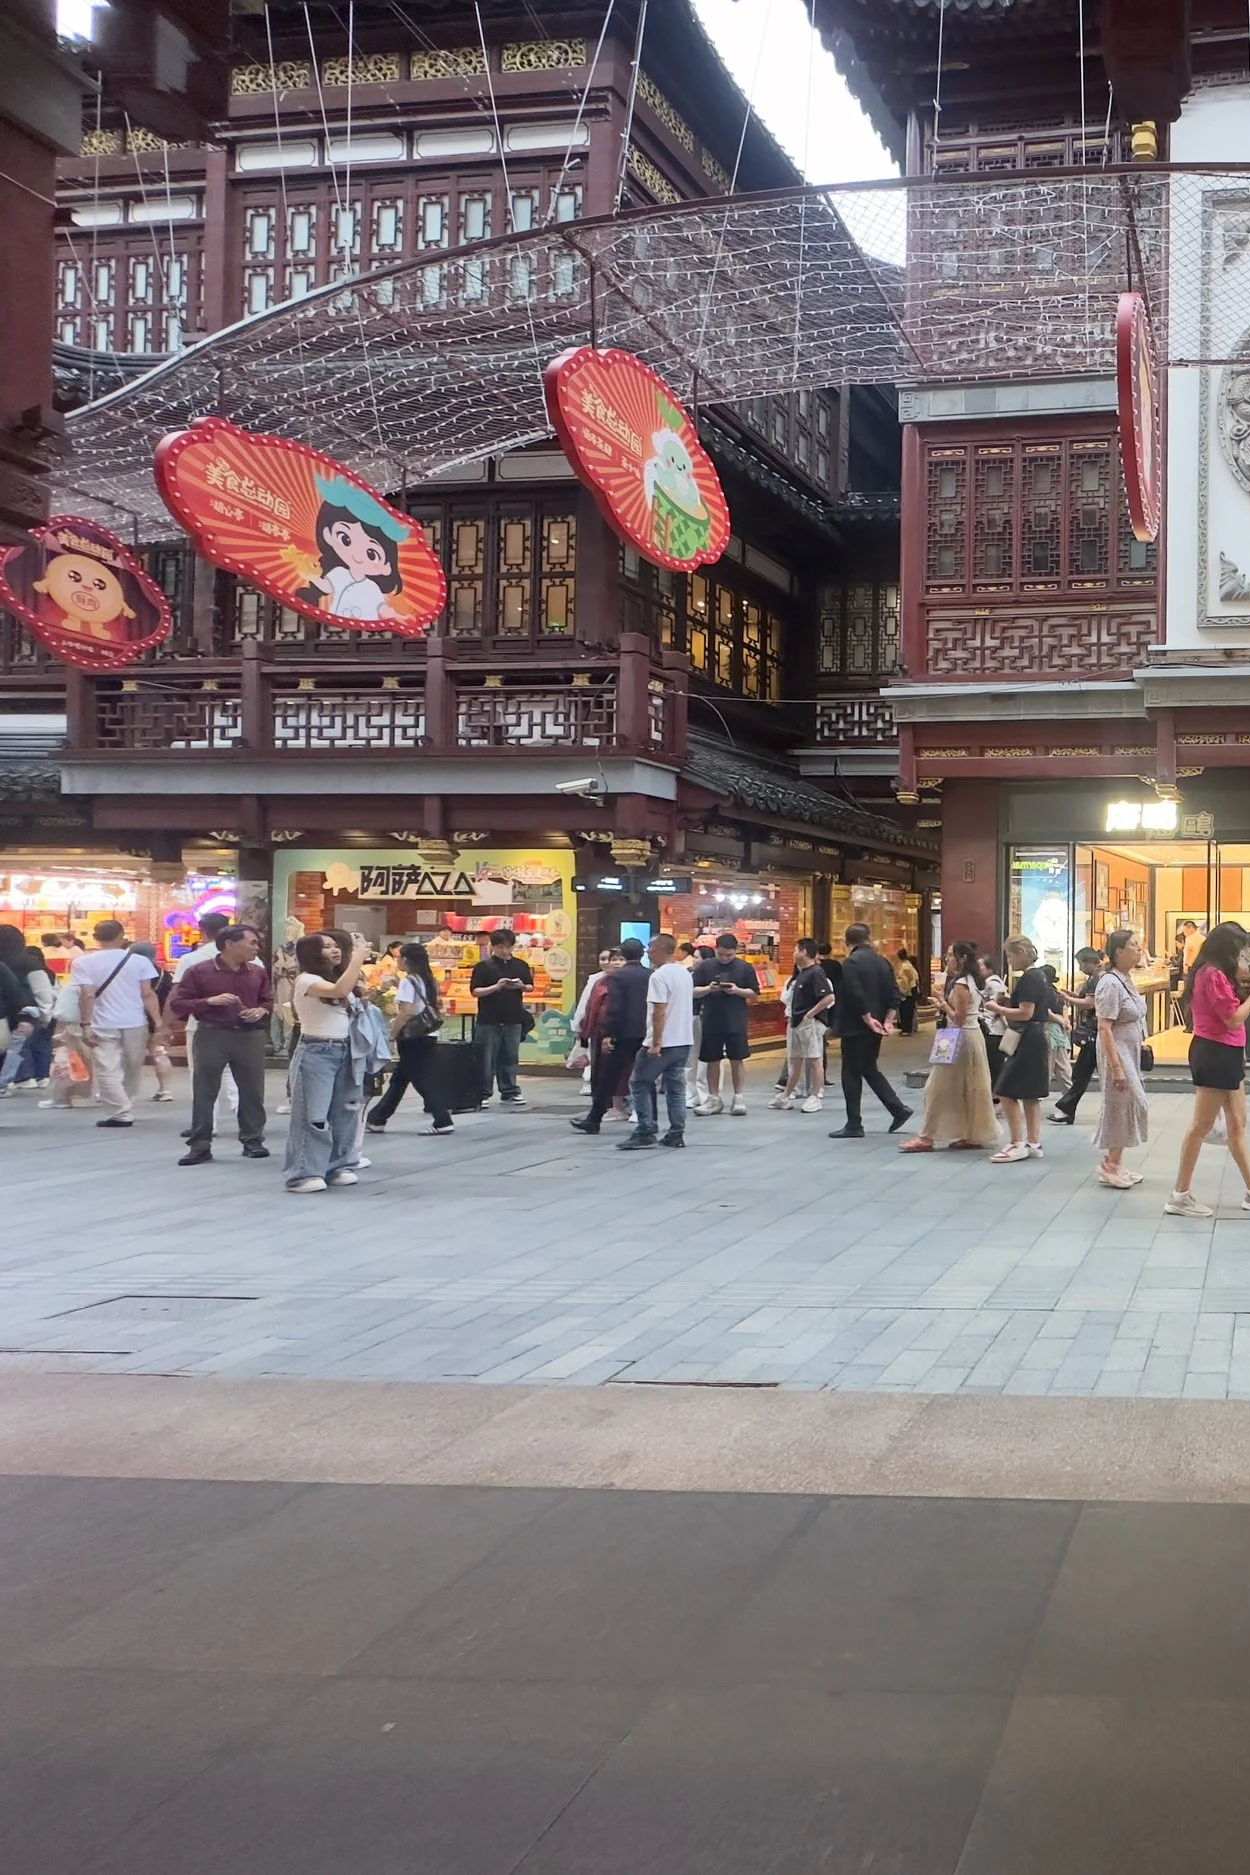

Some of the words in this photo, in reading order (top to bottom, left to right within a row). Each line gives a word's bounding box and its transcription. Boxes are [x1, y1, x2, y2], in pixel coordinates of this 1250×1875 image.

[205, 457, 291, 520] 美食总动园
